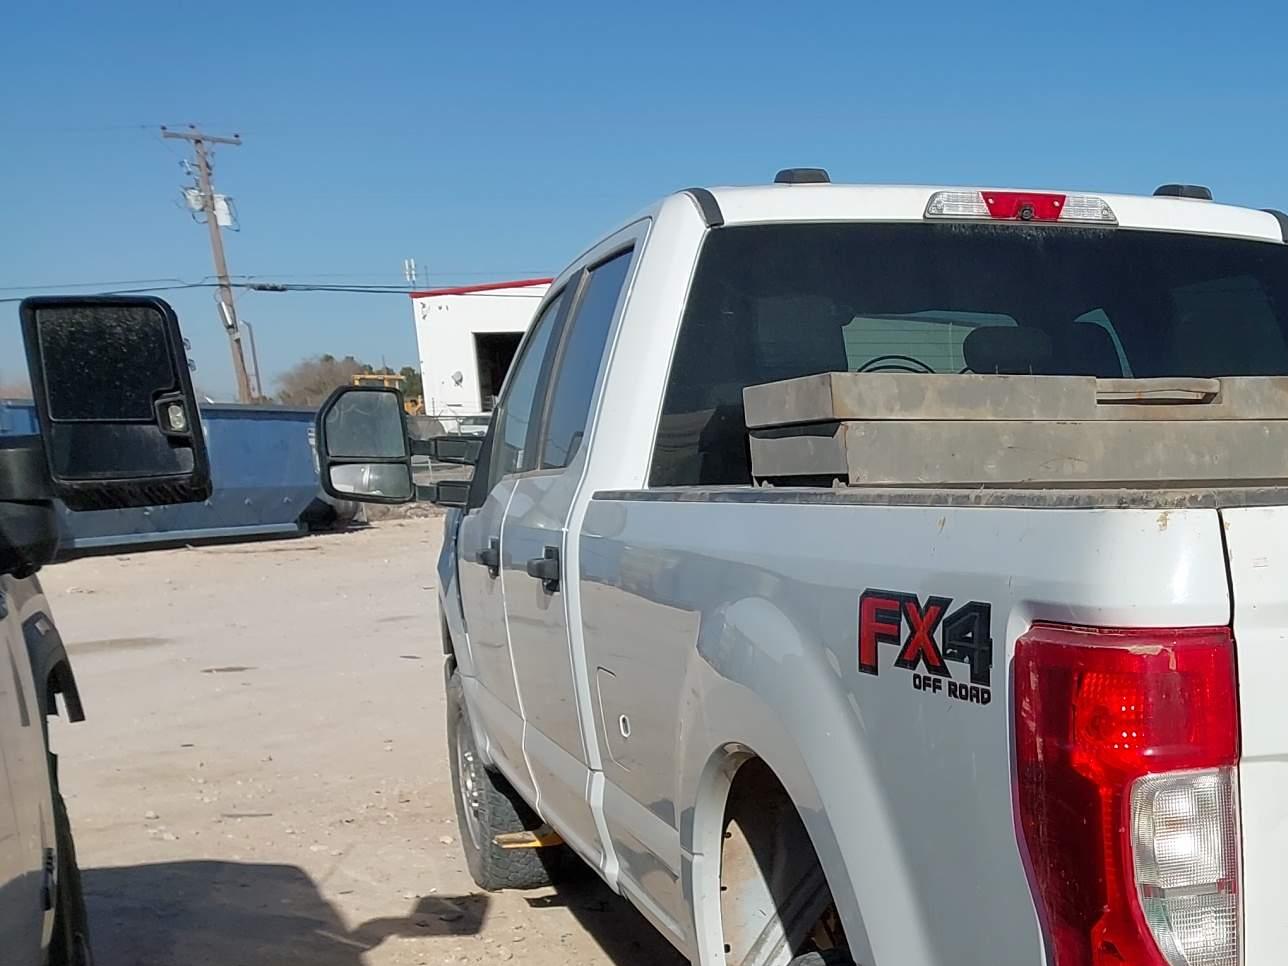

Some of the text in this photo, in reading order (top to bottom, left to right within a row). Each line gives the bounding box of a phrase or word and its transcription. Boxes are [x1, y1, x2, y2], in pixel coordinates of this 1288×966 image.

[858, 588, 992, 687] FX4
[913, 673, 992, 705] OFF ROAD
